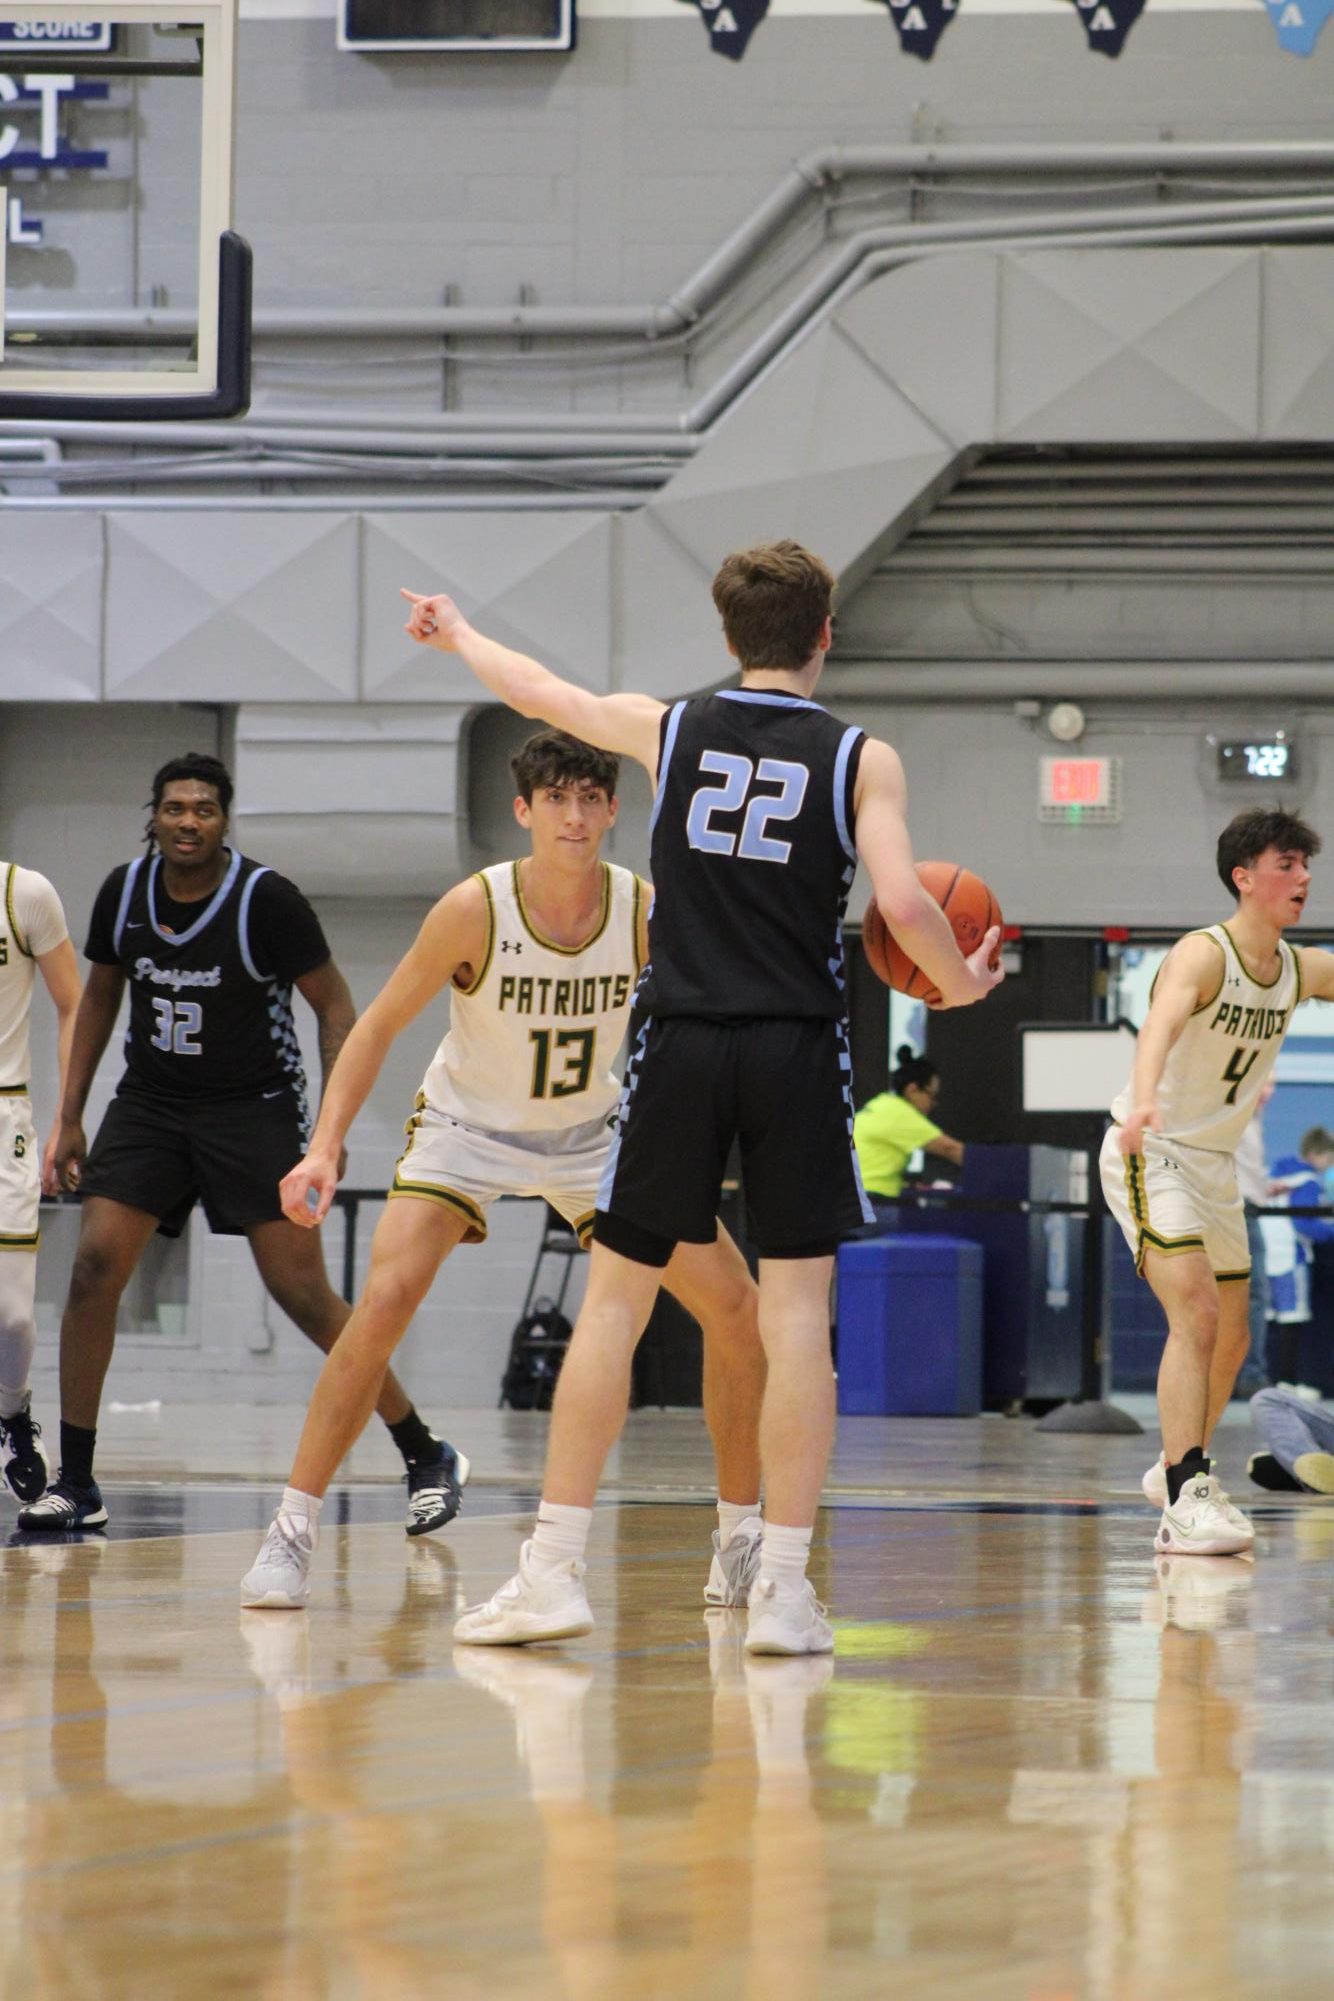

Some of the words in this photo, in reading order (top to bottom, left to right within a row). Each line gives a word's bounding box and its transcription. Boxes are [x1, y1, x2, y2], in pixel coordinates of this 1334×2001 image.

[686, 750, 809, 865] 22
[499, 975, 630, 1016] PATRIOTS
[1210, 1002, 1289, 1040] PATRIO
[150, 997, 203, 1055] 32
[528, 1026, 597, 1099] 13
[1221, 1047, 1260, 1106] 4
